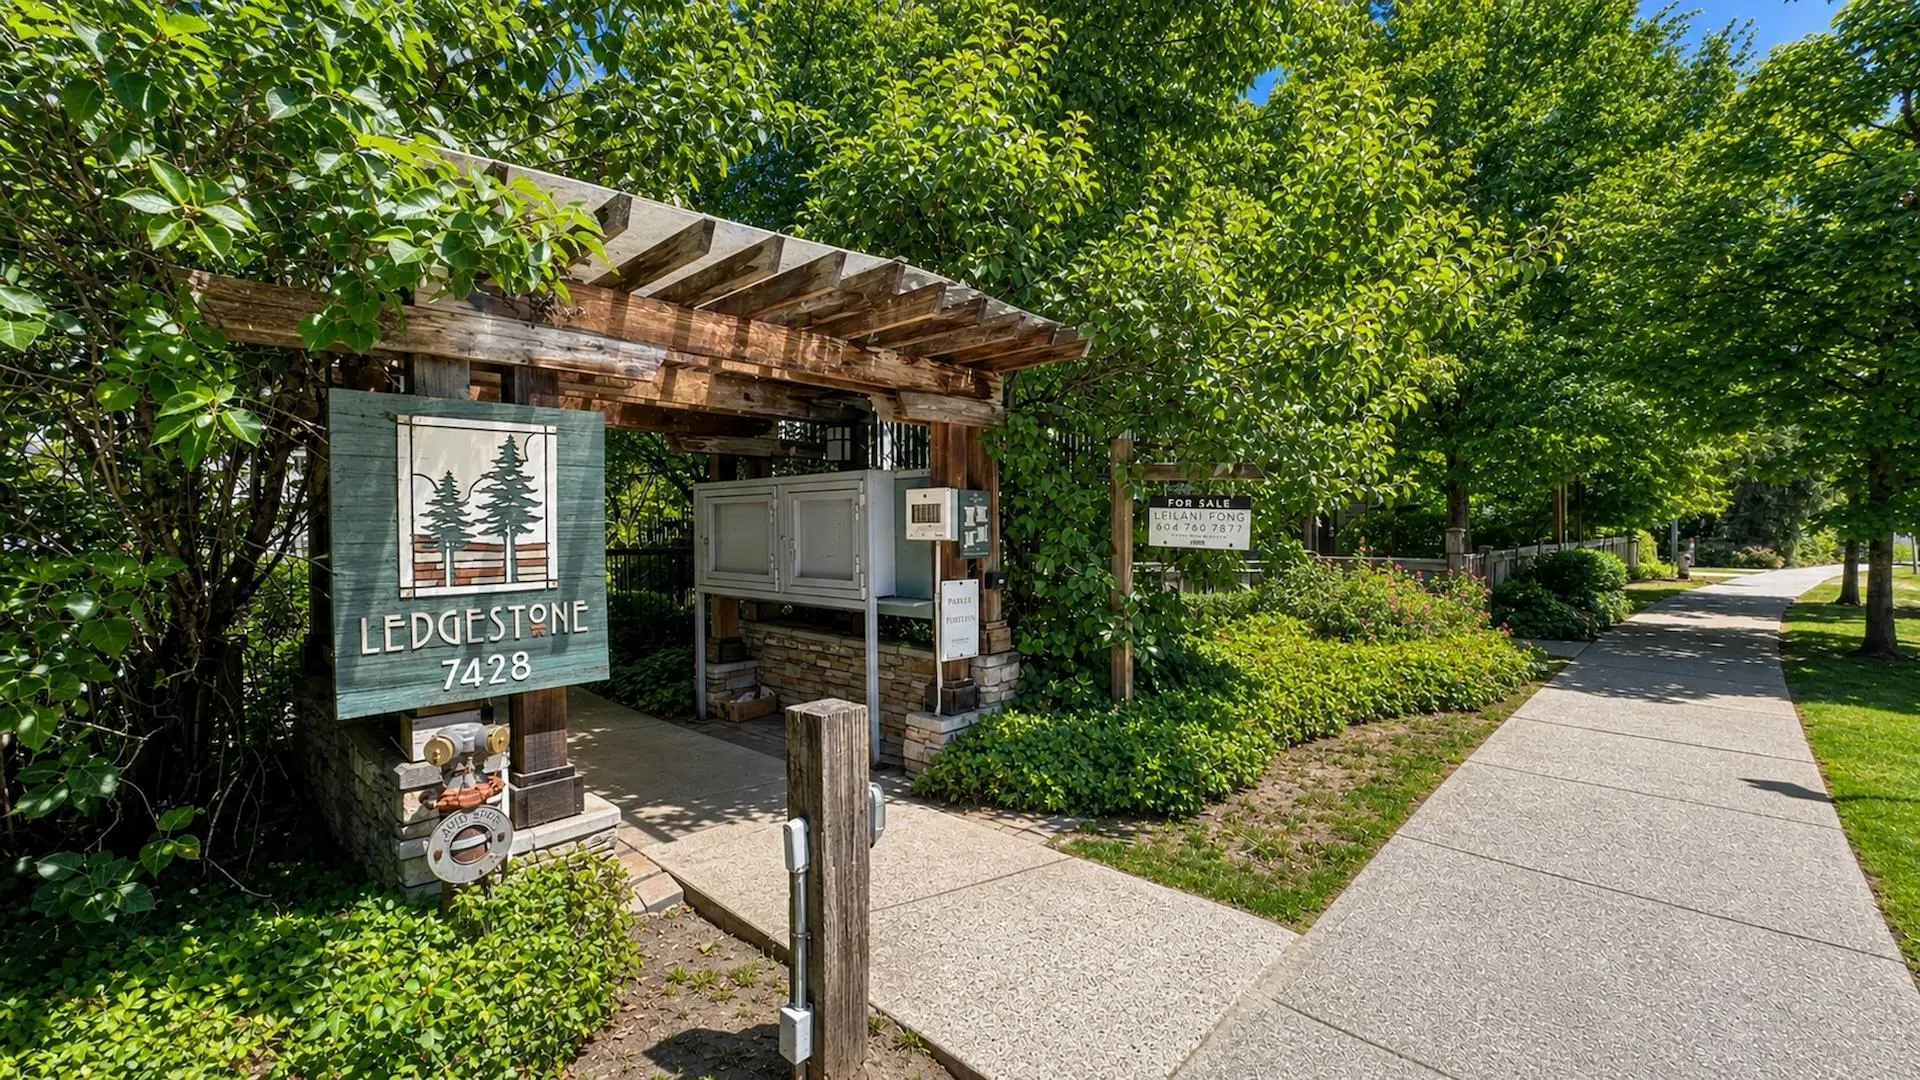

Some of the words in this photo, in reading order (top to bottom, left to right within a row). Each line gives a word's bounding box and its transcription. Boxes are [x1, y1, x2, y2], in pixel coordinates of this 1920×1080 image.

[1168, 499, 1192, 508] FOR
[1199, 499, 1230, 508] SALE
[1154, 511, 1202, 520] LEILANI
[1209, 512, 1245, 522] FONG
[1156, 523, 1178, 532] 604
[1184, 523, 1206, 532] 760
[1211, 524, 1242, 533] 7877
[360, 600, 589, 655] LEDGESTONE
[441, 651, 532, 691] 7428
